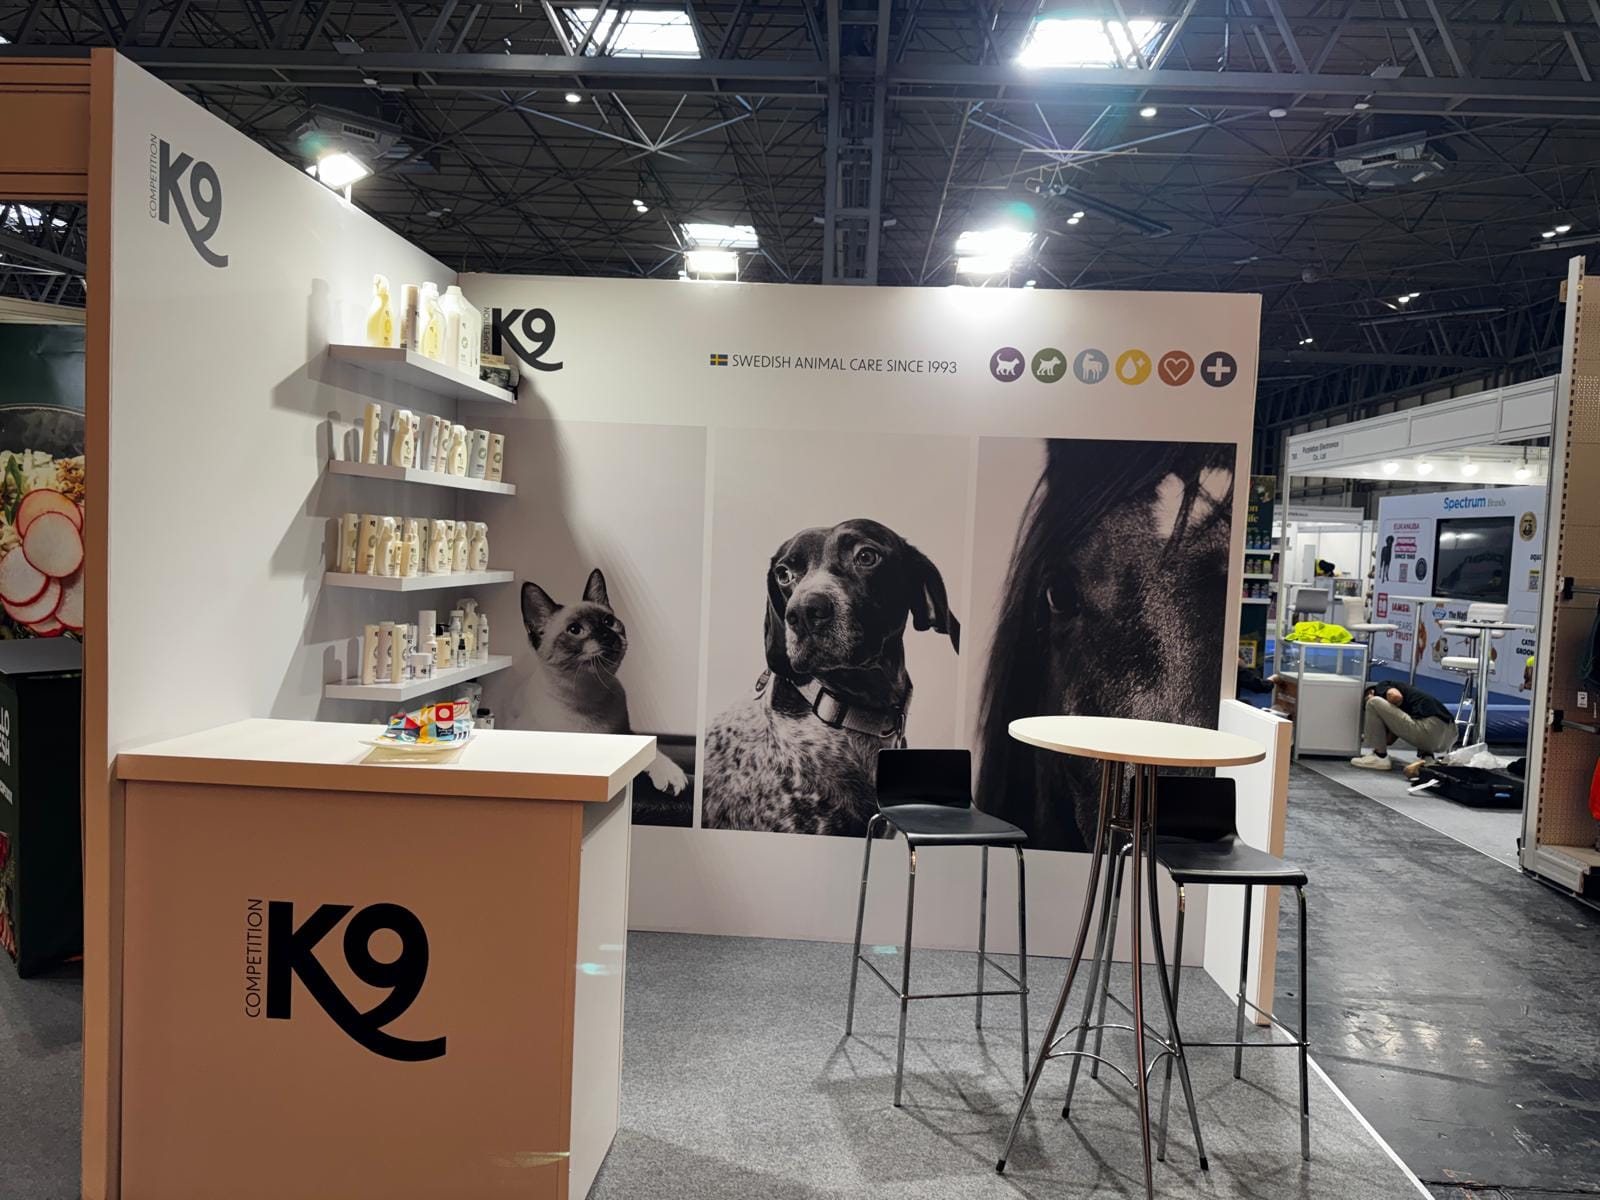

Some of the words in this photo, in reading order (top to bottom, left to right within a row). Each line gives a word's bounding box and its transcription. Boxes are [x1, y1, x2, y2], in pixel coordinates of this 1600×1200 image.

[149, 133, 158, 219] COMPETITION
[158, 138, 229, 268] K9
[491, 307, 564, 372] K9
[732, 354, 791, 369] SWEDISH
[794, 356, 847, 371] ANIMAL
[849, 357, 883, 372] CARE
[886, 359, 924, 373] SINCE
[927, 360, 958, 374] 1993
[1443, 496, 1487, 511] Spectrum
[1395, 630, 1413, 642] TRUST
[1448, 611, 1457, 619] The
[246, 898, 263, 1018] COMPETITION
[266, 900, 447, 1062] K9
